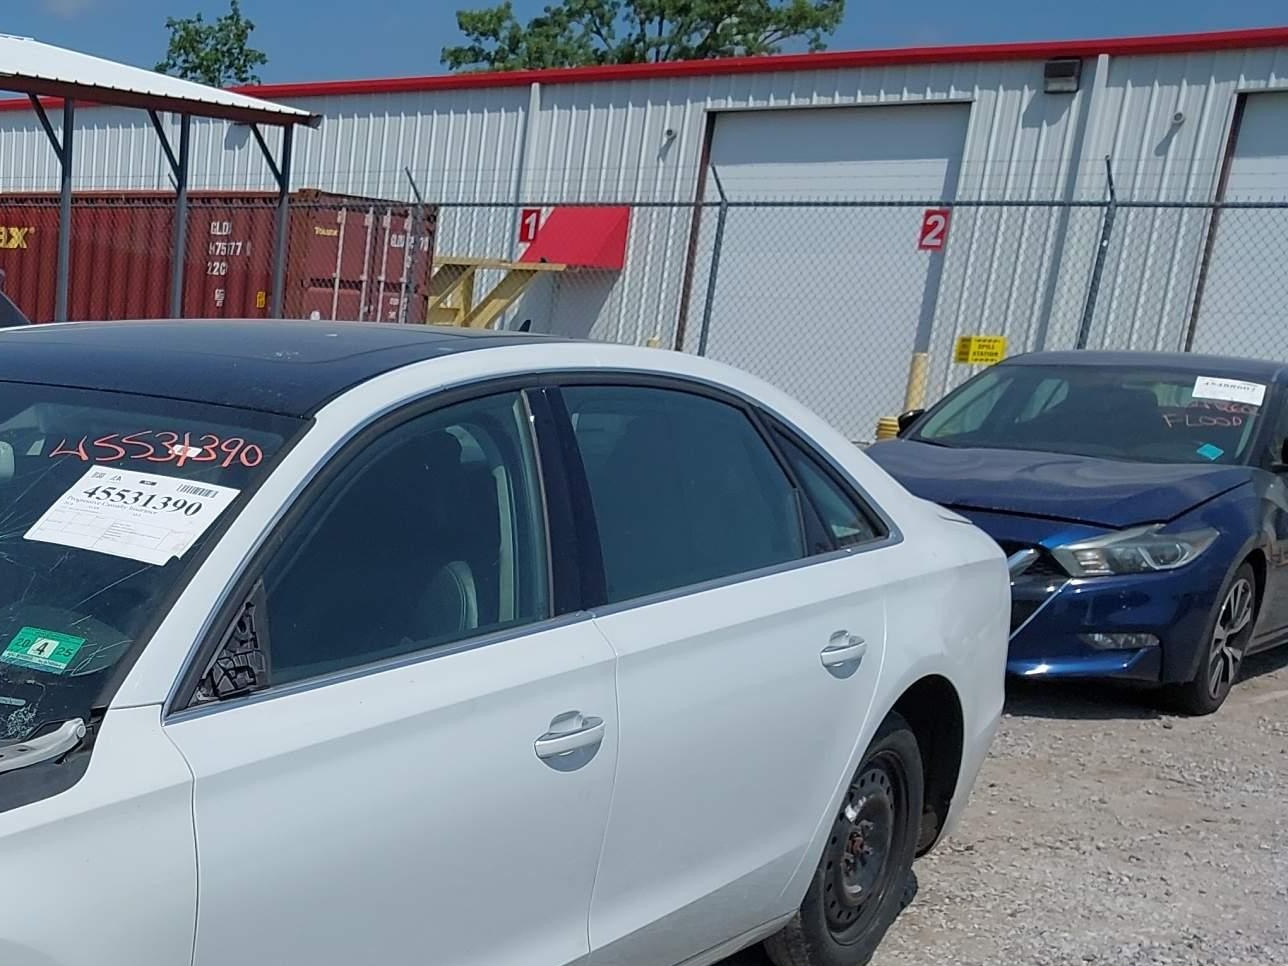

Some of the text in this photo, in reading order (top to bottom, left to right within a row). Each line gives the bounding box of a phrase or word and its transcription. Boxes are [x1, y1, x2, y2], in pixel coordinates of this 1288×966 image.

[524, 211, 537, 241] 1
[922, 214, 946, 246] 2
[1162, 413, 1243, 429] FLOOD
[49, 430, 263, 469] 45531390
[83, 484, 204, 518] 45531390
[15, 638, 73, 657] 20 4 25
